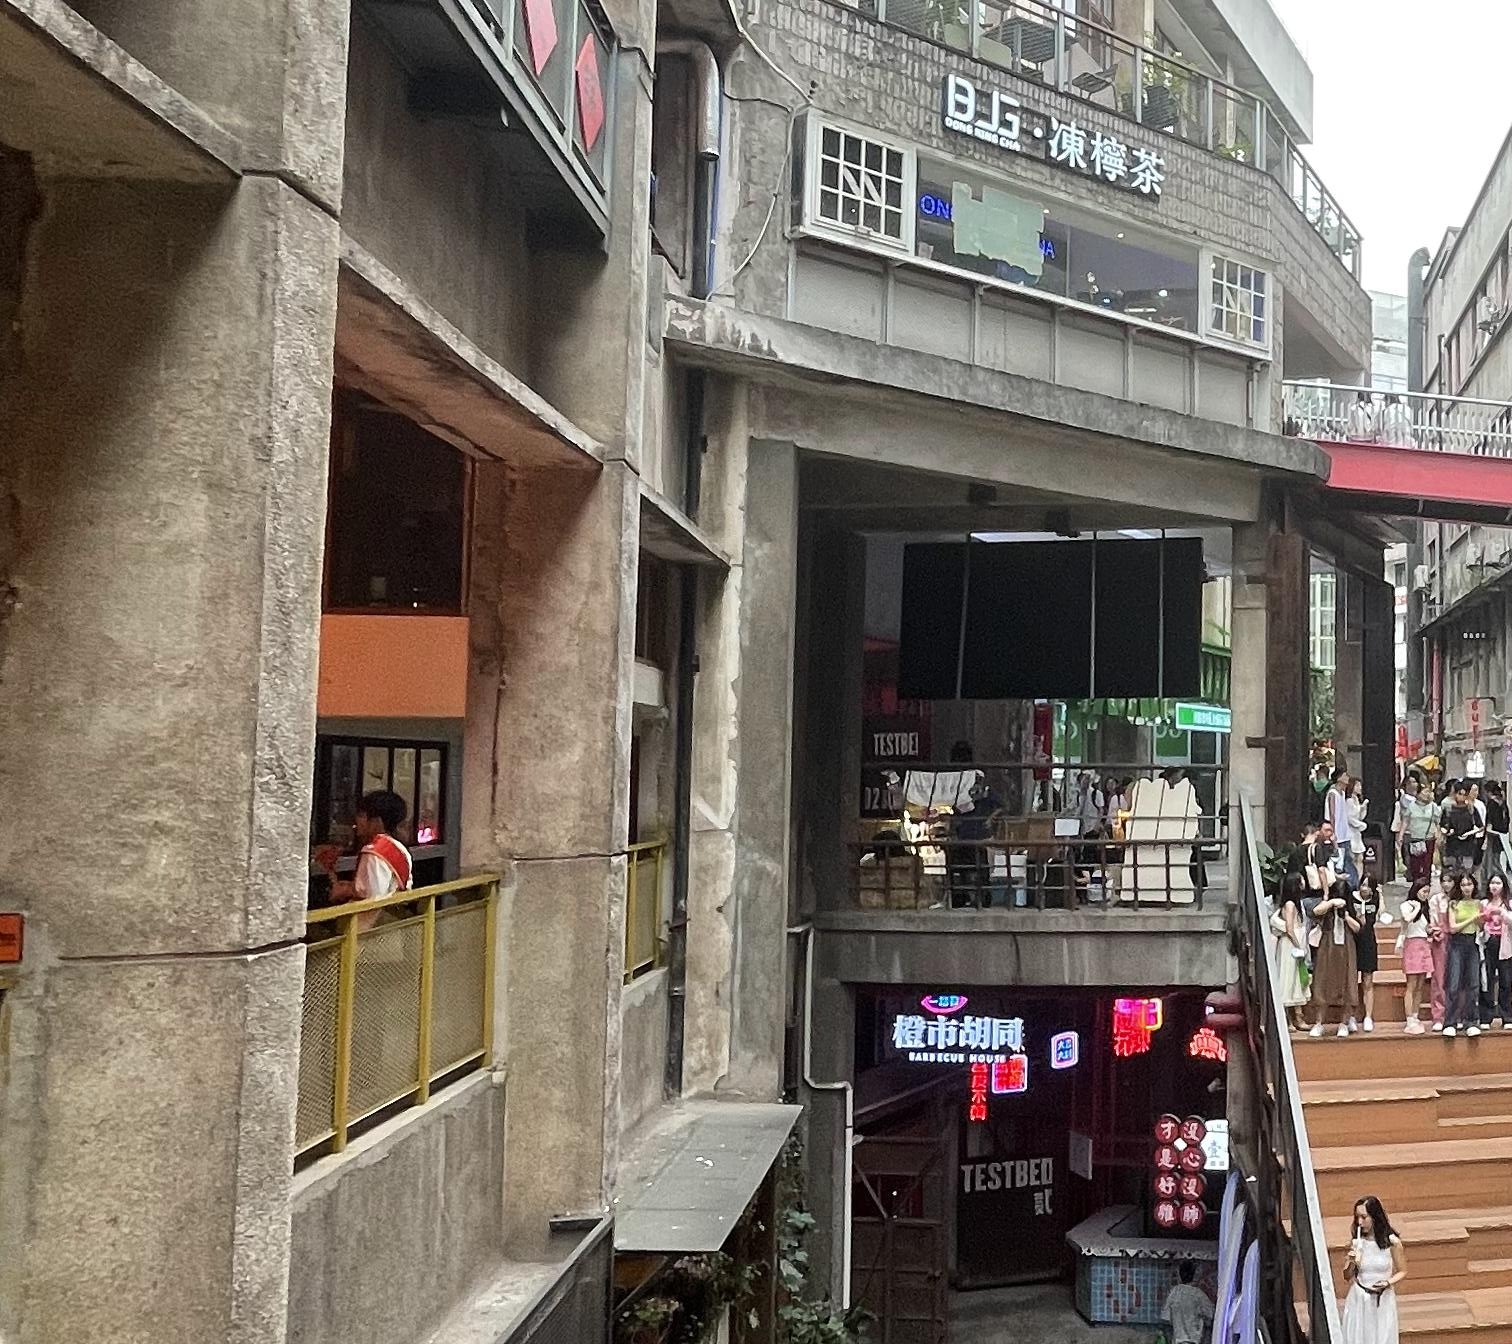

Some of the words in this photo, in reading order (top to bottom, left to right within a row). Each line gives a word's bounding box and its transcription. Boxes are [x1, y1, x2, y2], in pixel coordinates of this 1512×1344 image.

[1049, 117, 1165, 195] 凍檸茶
[892, 1015, 1024, 1052] 橙市胡同
[909, 1052, 965, 1063] BARBECUE
[969, 1053, 1007, 1064] HOUSE
[961, 1158, 1053, 1193] TESTBED
